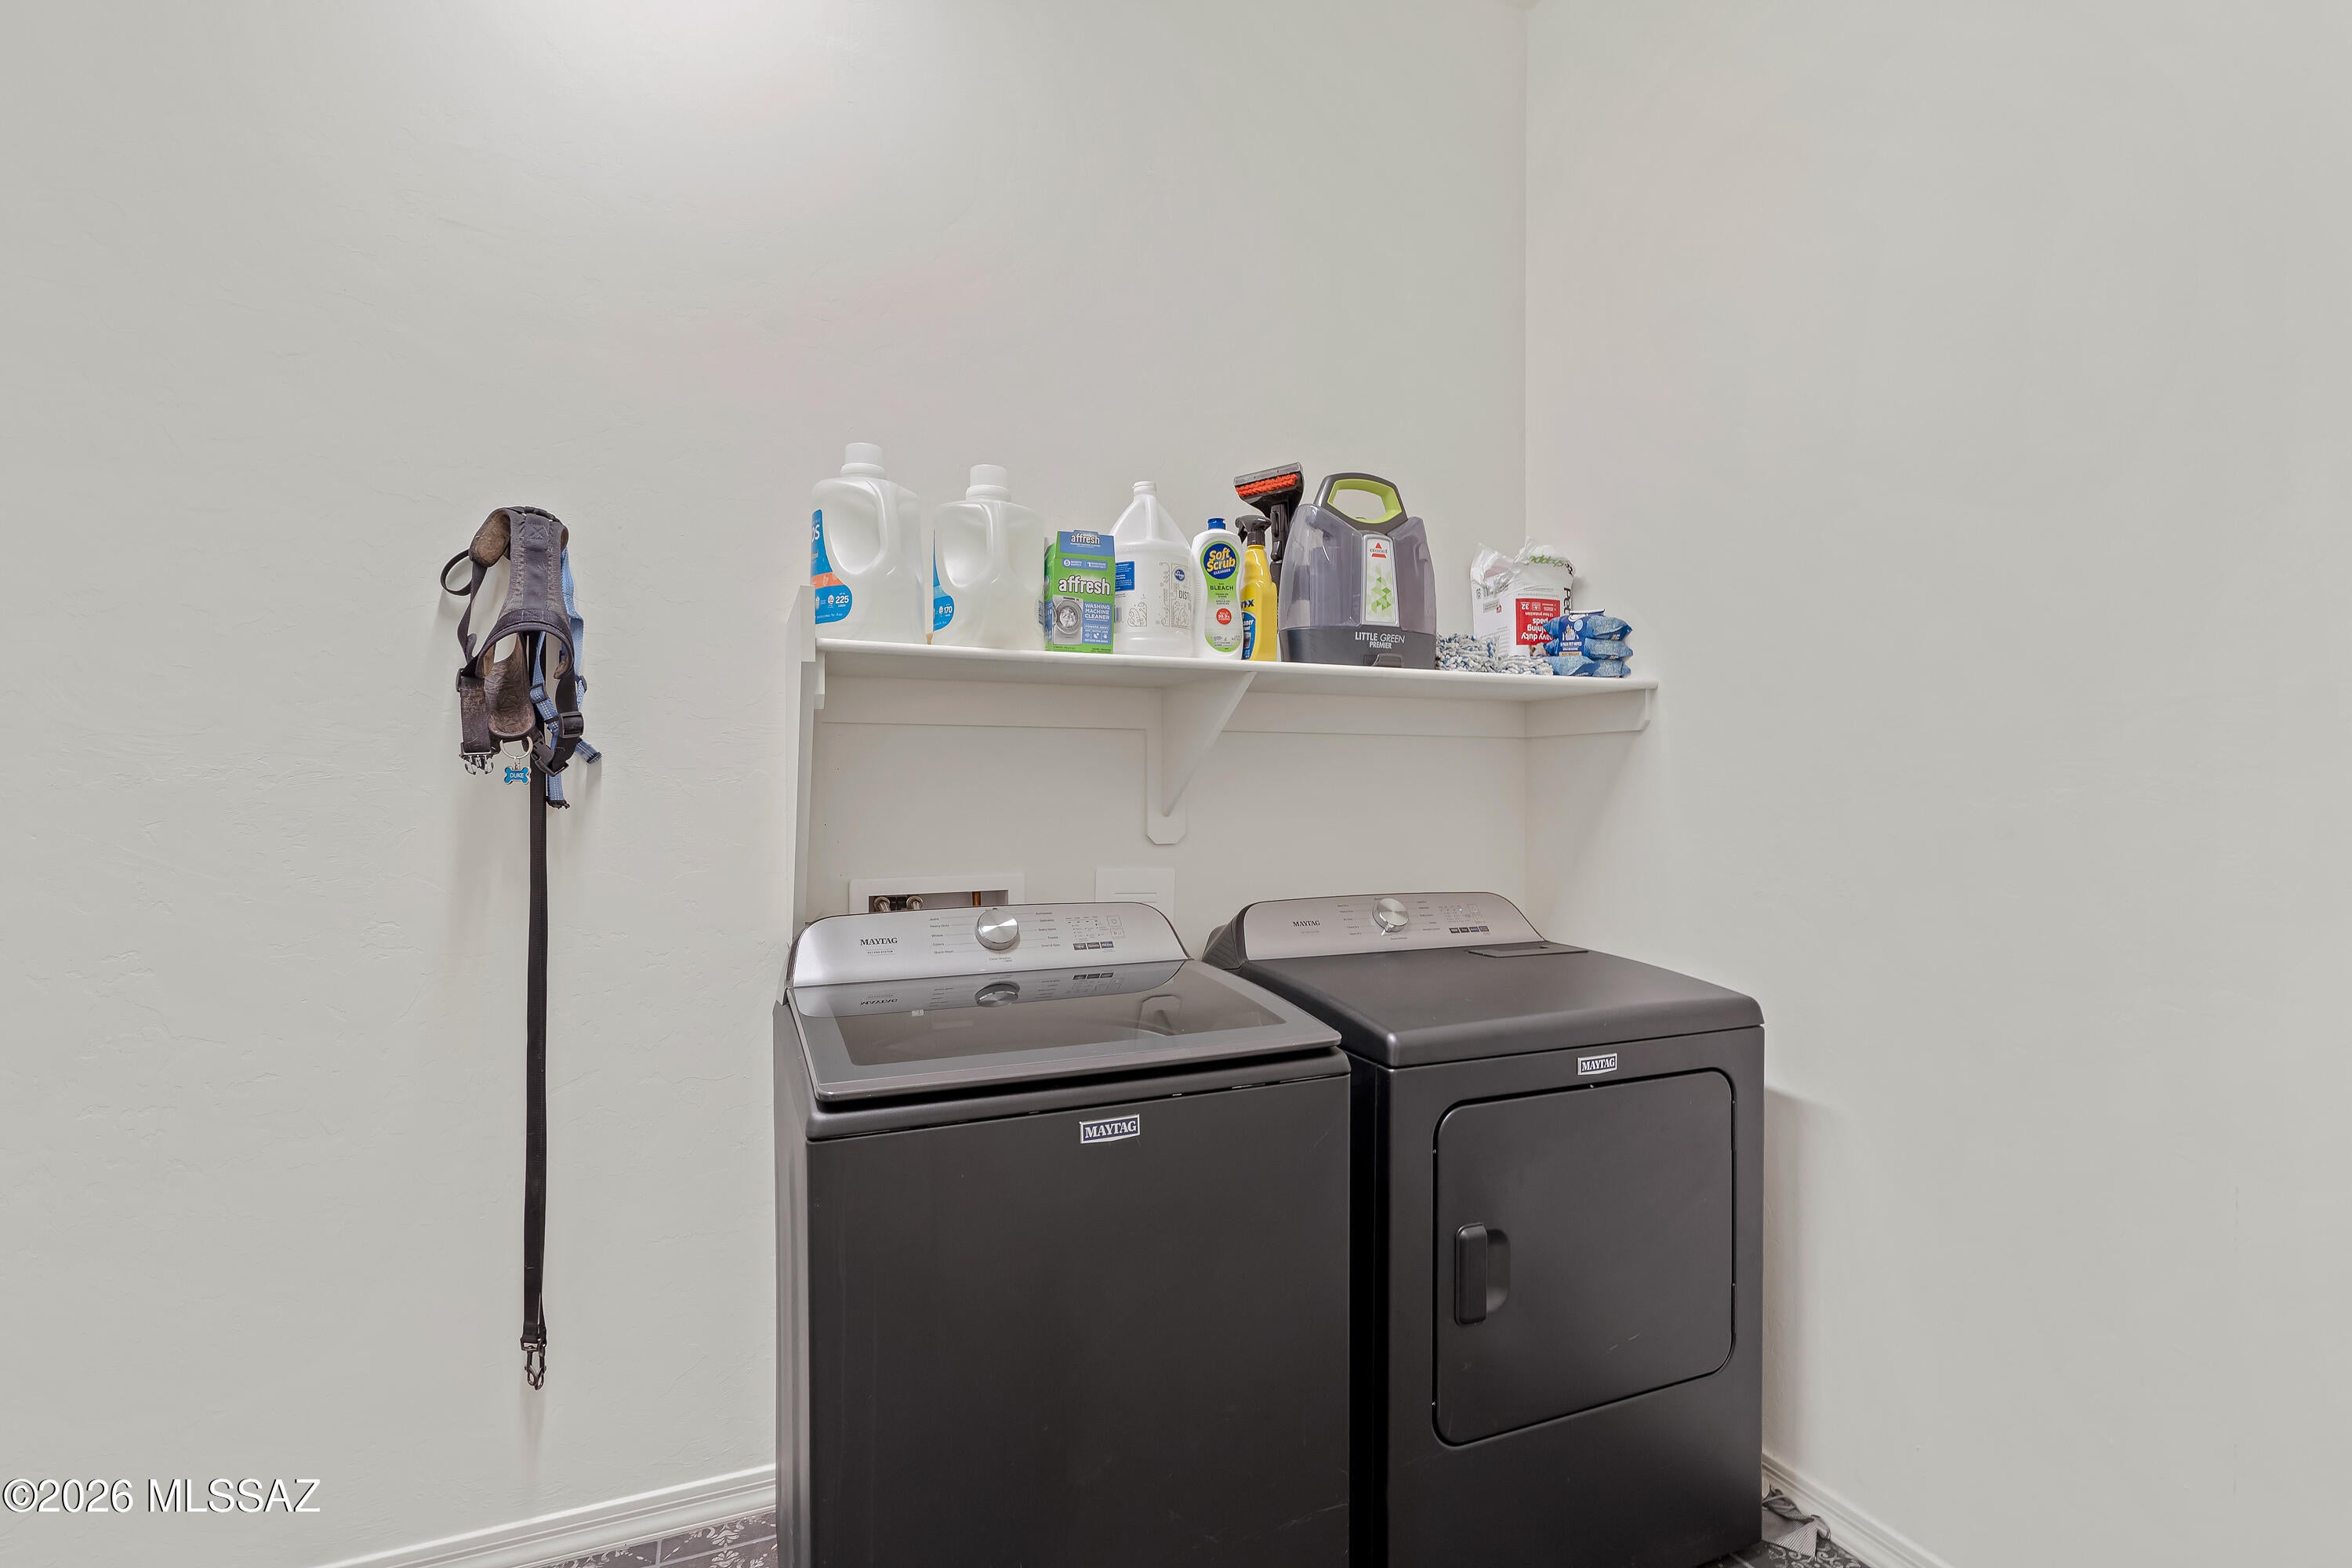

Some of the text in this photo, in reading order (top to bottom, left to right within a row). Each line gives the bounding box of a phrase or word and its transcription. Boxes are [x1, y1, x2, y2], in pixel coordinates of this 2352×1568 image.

[1071, 533, 1100, 545] affresh
[1210, 547, 1230, 561] Soft
[1207, 557, 1236, 572] Scrub
[1058, 575, 1110, 596] affresh
[836, 595, 849, 604] 225
[944, 605, 953, 614] 170
[1356, 632, 1405, 643] LITTLE GREEN
[1521, 632, 1538, 641] duty
[860, 937, 898, 946] MAYTAG
[1581, 1058, 1615, 1071] MAYTAG
[1085, 1120, 1137, 1138] MAYTAG
